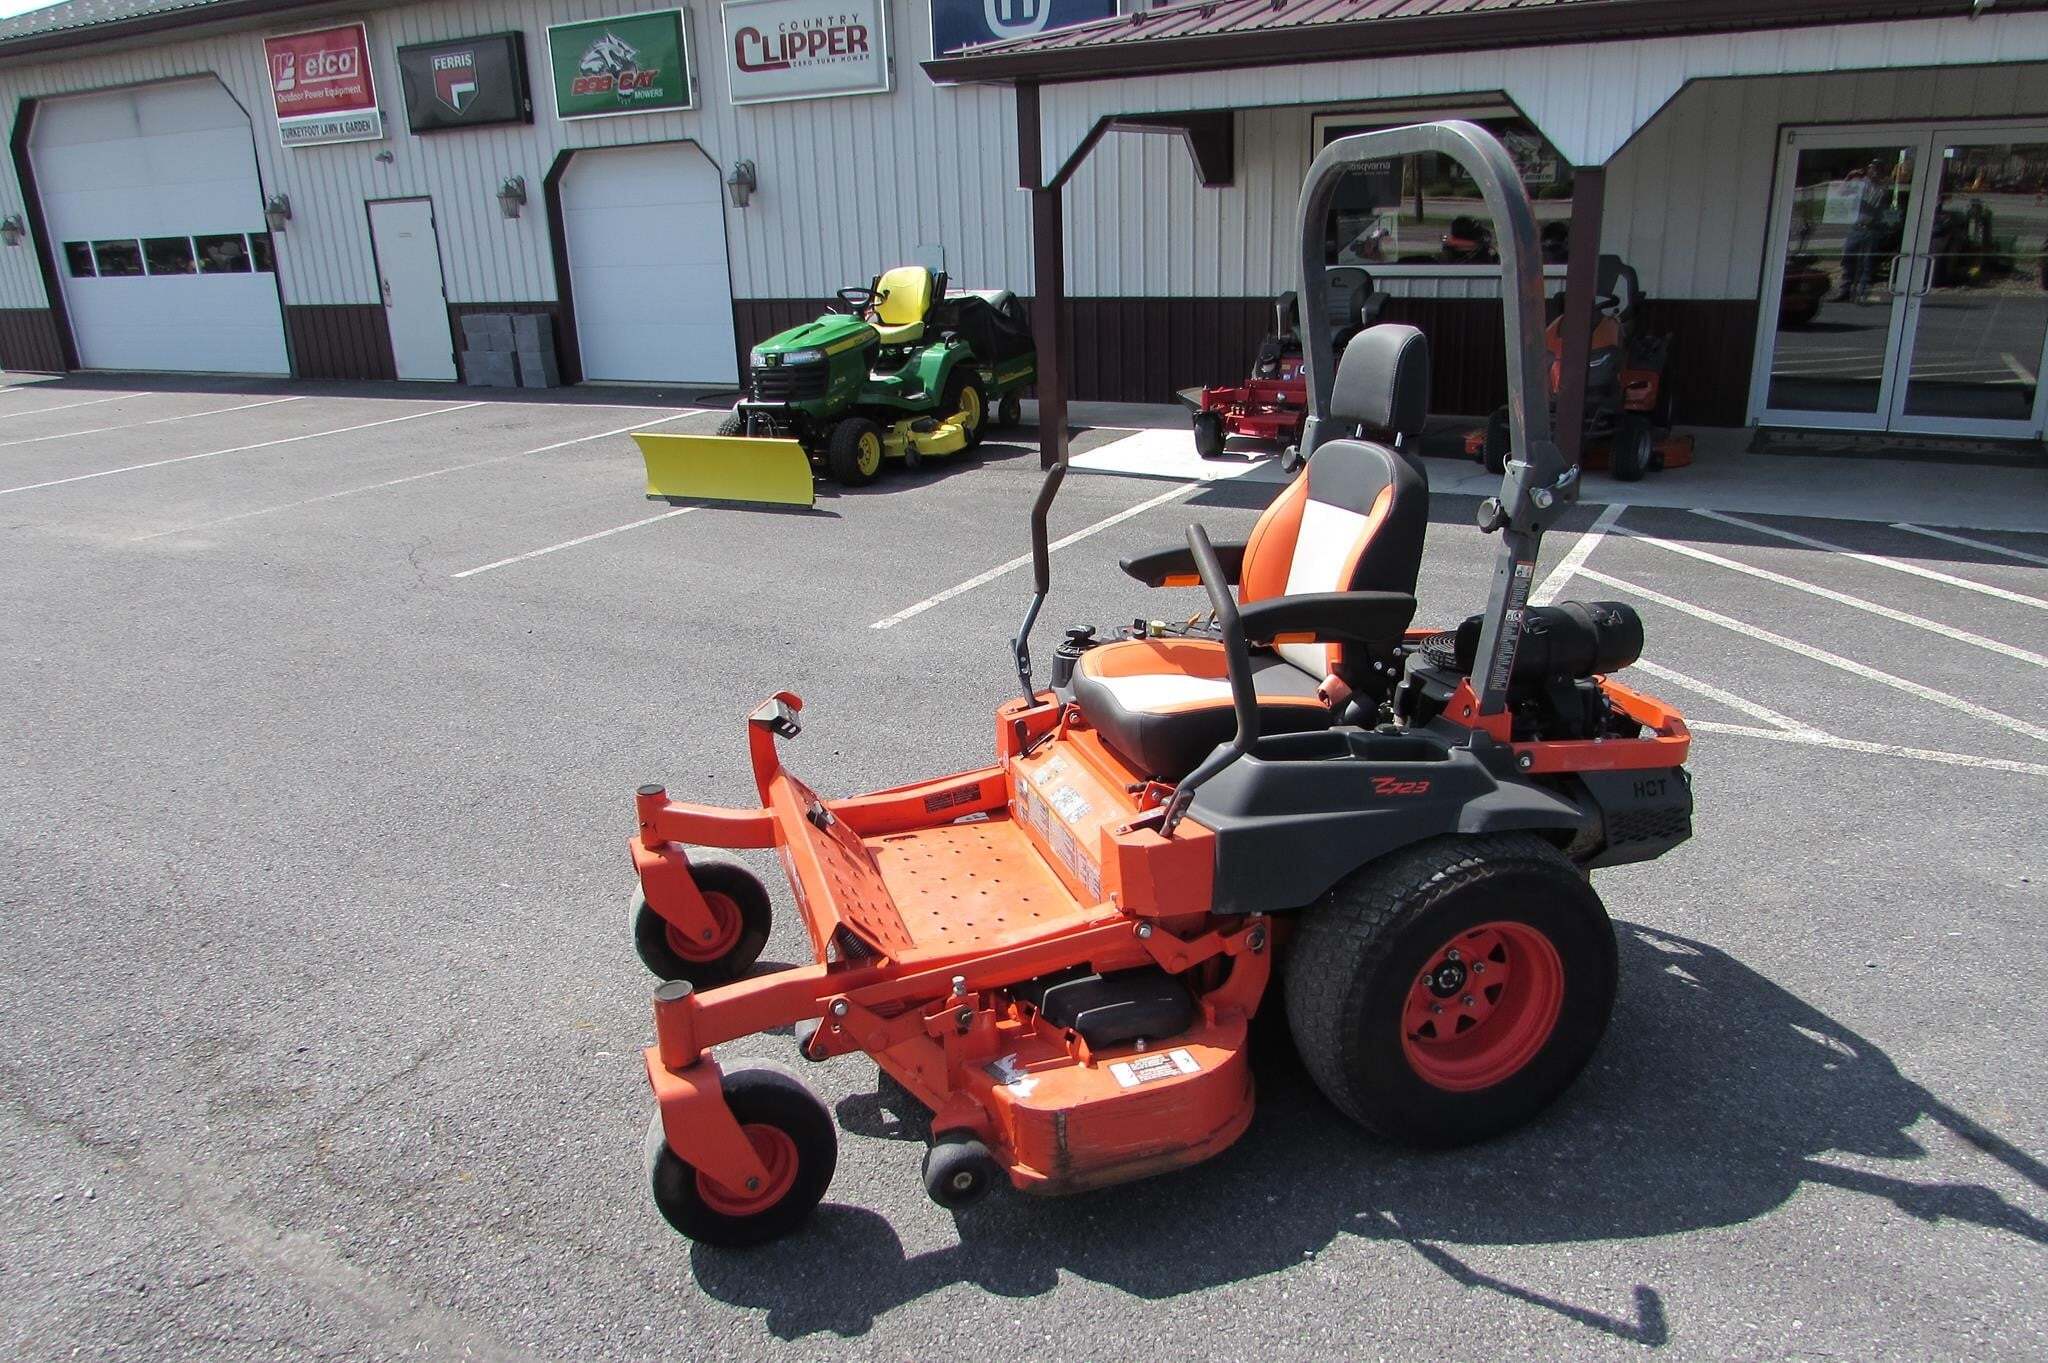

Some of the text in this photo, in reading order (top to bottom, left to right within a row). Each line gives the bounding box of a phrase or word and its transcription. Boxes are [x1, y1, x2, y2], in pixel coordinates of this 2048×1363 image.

[779, 14, 859, 32] COUNTRY
[735, 25, 869, 73] CLIPPER
[841, 54, 870, 62] MOWER
[305, 50, 352, 77] efco
[434, 53, 473, 71] FERRIS
[277, 84, 362, 103] Outdoor Power Equipment
[634, 88, 664, 99] MOWERS
[281, 119, 372, 139] TURKEYFOOT LAWN & GARDEN
